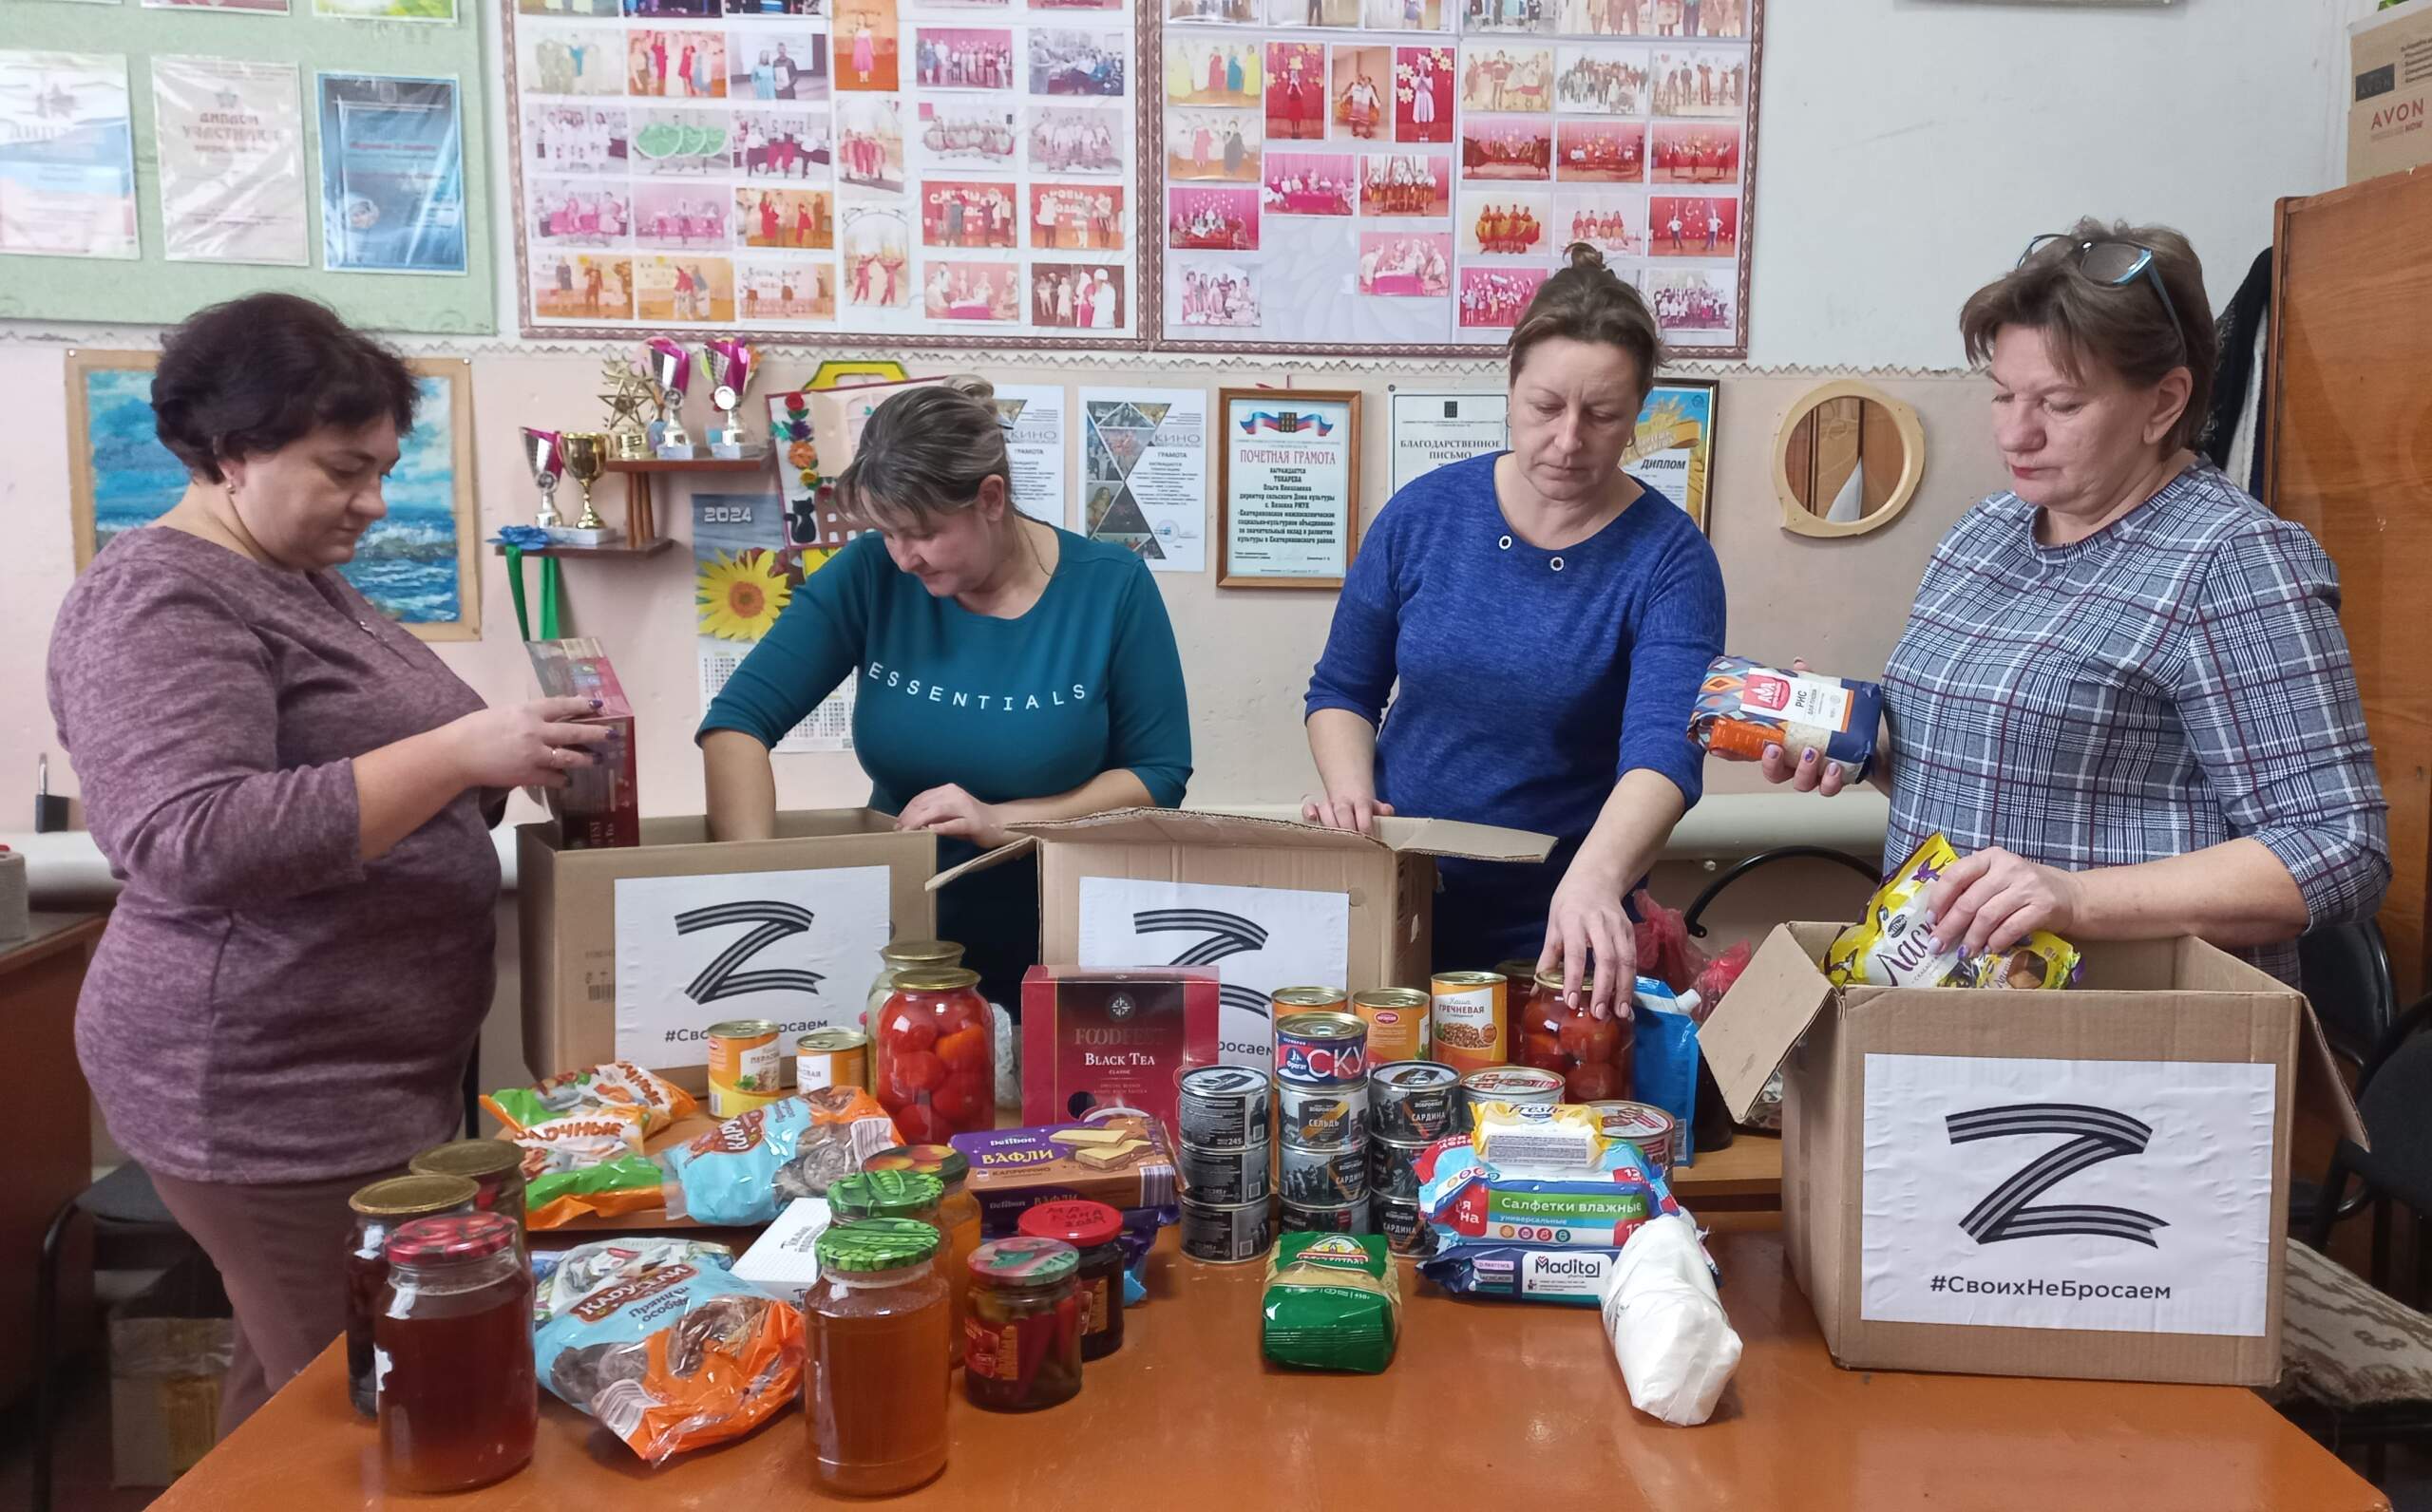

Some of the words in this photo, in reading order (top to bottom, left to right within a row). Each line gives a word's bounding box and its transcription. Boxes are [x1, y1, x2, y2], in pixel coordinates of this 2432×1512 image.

[2371, 98, 2423, 129] AVON
[1155, 434, 1201, 443] КИНО
[1400, 440, 1501, 448] БЛАГОДАРСТВЕННОЕ
[1240, 449, 1289, 463] ПОЧЕТНАЯ
[1294, 451, 1336, 464] ГРАМОТА
[1429, 451, 1472, 460] ПИСЬМО
[1641, 459, 1686, 469] ДИПЛОМ
[704, 506, 752, 523] 2024
[868, 661, 1086, 710] ESSENTIALS
[1796, 690, 1807, 708] РИС
[1438, 1004, 1485, 1014] ГРЕЧНЕВАЯ
[1308, 1119, 1340, 1127] СЕЛЬДЬ
[1412, 1112, 1445, 1122] САРДИНА
[981, 1148, 1054, 1164] ВАФЛИ
[1946, 1104, 2170, 1249] Z
[1502, 1197, 1574, 1213] Салфетки
[1579, 1200, 1642, 1213] влажные
[1499, 1215, 1568, 1225] универсальные
[1383, 1222, 1416, 1234] САРДИНА
[1535, 1255, 1601, 1277] Maditol
[1930, 1275, 2171, 1300] #СвоихНеБросаем
